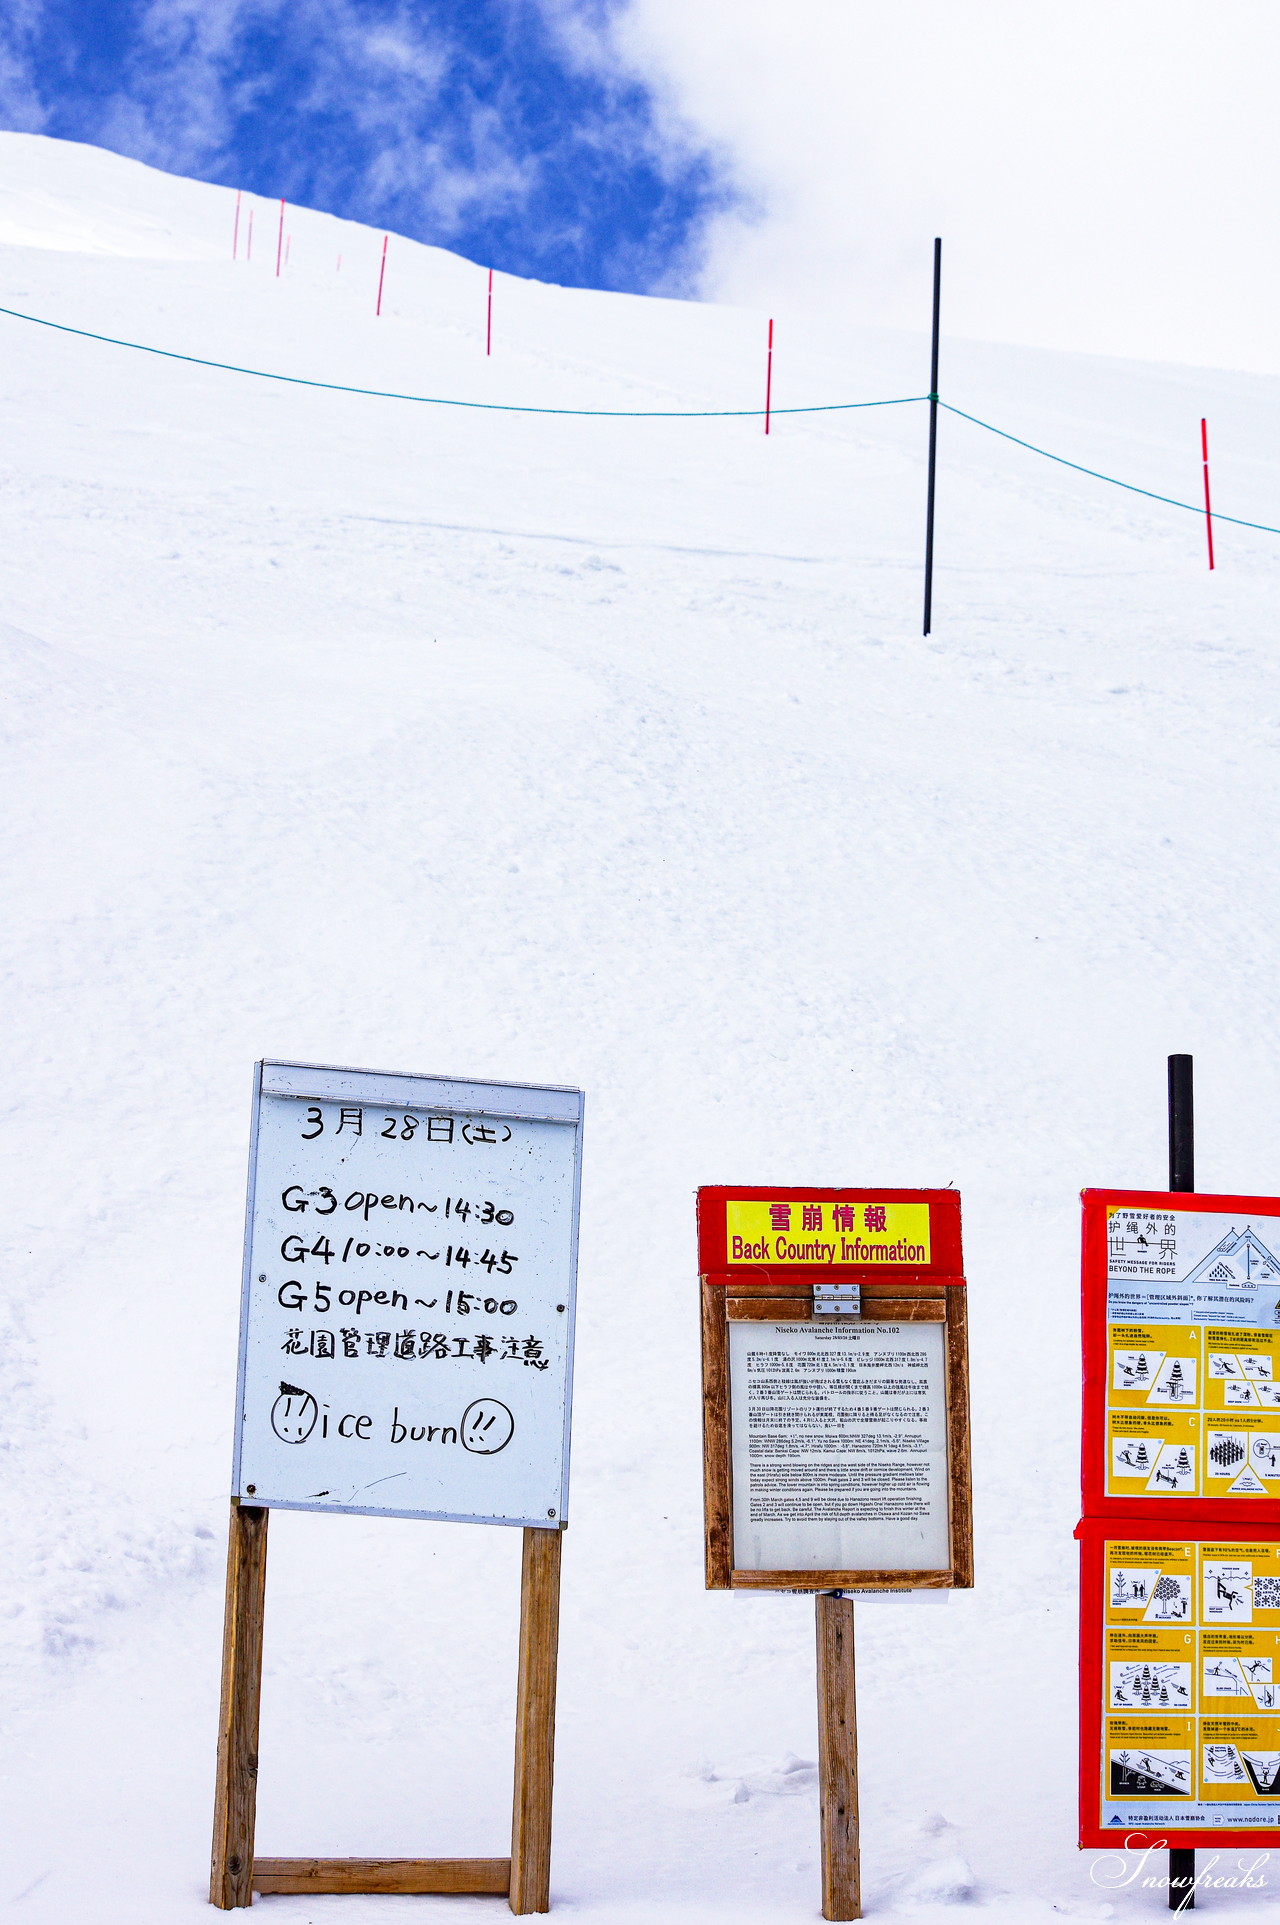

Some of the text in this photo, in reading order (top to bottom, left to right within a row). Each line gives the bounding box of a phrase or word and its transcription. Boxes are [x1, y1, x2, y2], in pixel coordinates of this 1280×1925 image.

[769, 1204, 887, 1232] 雪崩情報
[1109, 1212, 1175, 1221] 为了野雪爱好者的安全
[1109, 1221, 1176, 1236] 护绳外的
[282, 1235, 335, 1264] G4
[732, 1236, 925, 1264] Back Country Information
[278, 1280, 332, 1312] G5
[1189, 1331, 1196, 1339] A
[322, 1402, 457, 1444] ice burn
[1189, 1417, 1195, 1427] C
[1185, 1548, 1191, 1556] E
[1184, 1634, 1191, 1644] G
[1187, 1722, 1191, 1731] I
